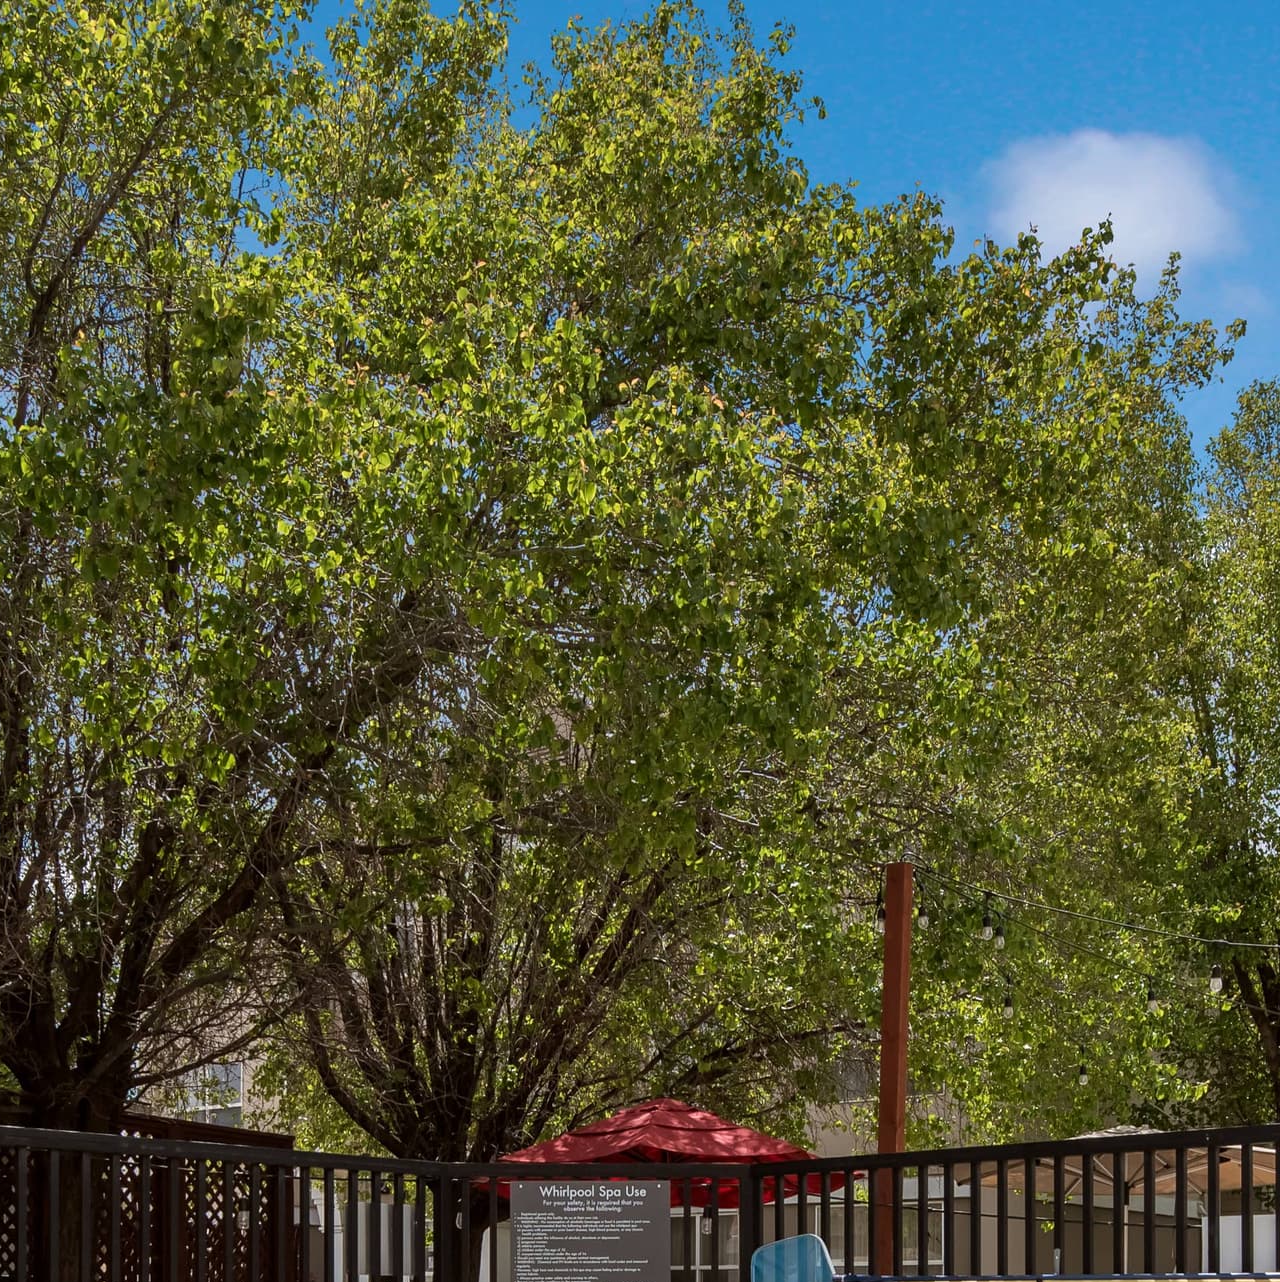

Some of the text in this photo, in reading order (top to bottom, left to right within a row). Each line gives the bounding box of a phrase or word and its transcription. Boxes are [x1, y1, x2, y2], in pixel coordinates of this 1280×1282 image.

[539, 1184, 647, 1200] Whirlpool Spa Use
